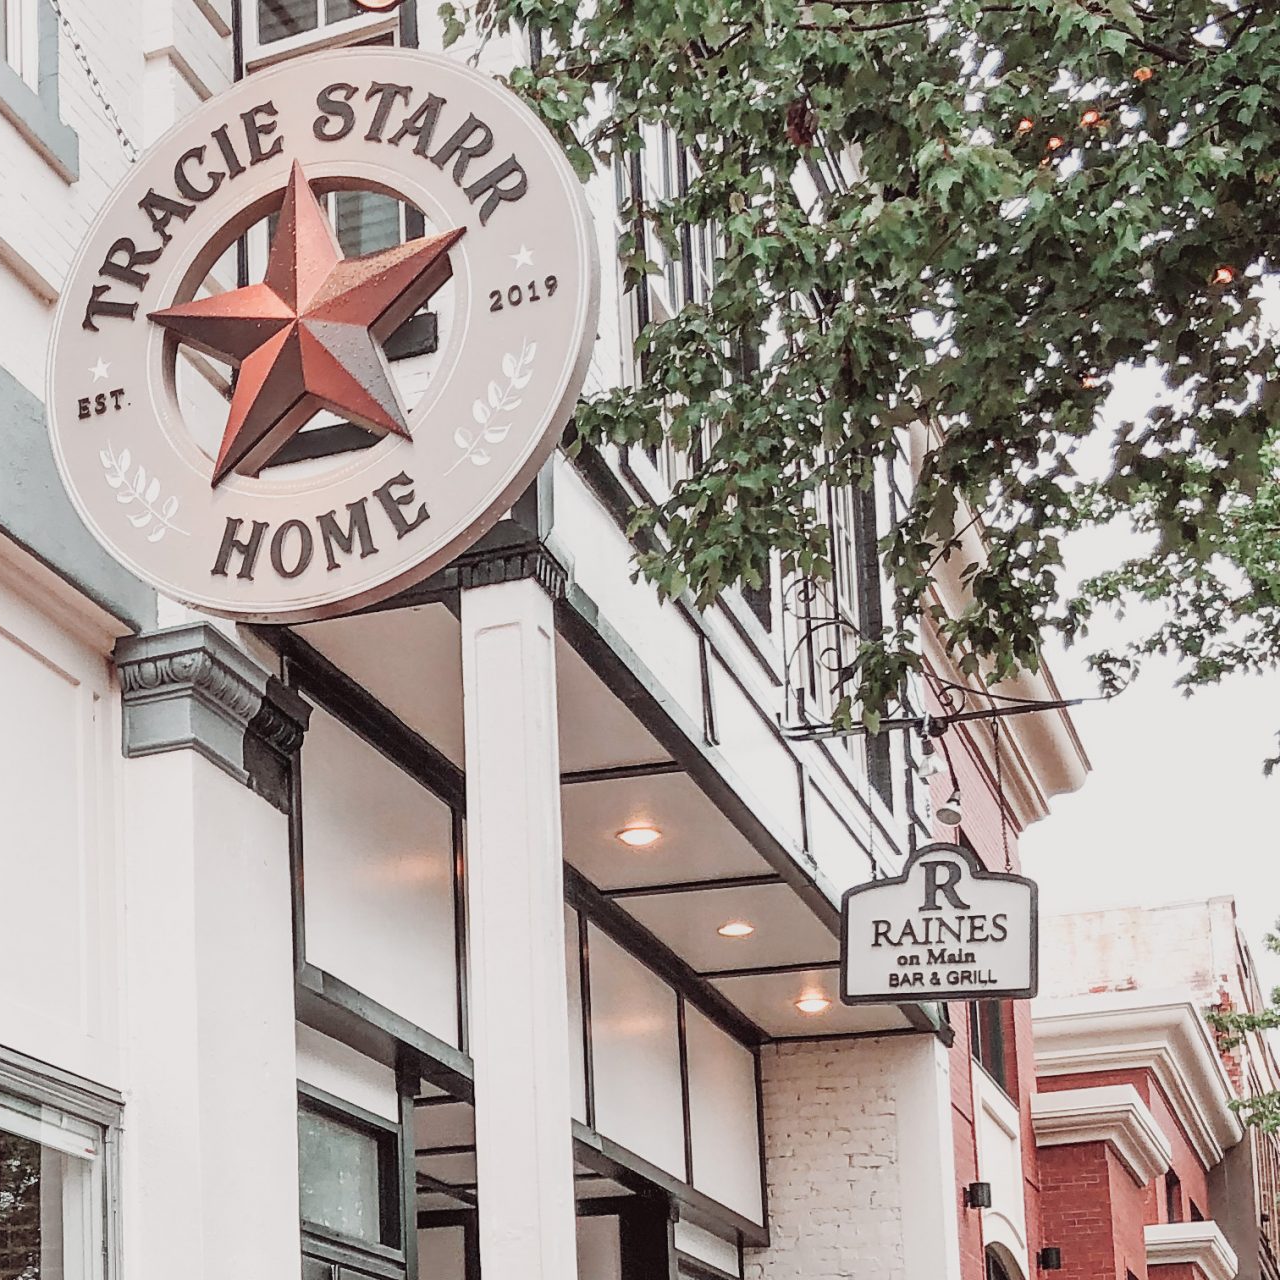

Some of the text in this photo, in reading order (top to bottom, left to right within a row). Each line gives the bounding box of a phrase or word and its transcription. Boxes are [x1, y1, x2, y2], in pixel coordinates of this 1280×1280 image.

[82, 81, 528, 332] TRACIE STARR
[488, 274, 559, 312] 2019
[77, 388, 131, 420] EST.
[211, 470, 431, 580] HOME
[918, 860, 970, 911] R
[871, 913, 1008, 947] RAINES
[897, 948, 976, 966] on Main
[889, 969, 998, 987] BAR & GRILL
